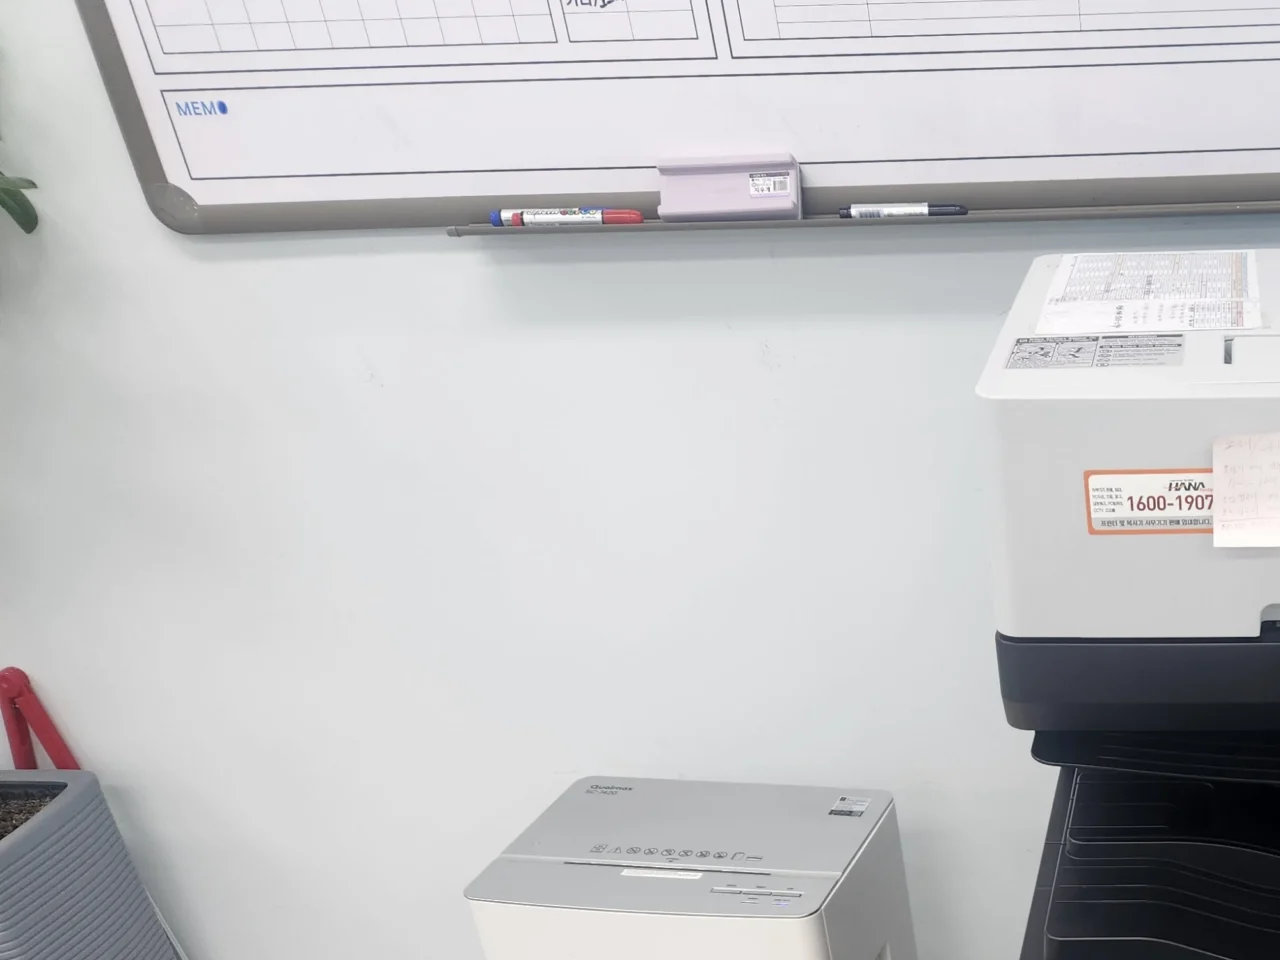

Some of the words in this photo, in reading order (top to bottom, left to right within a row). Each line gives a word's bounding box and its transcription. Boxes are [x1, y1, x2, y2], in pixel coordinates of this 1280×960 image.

[175, 100, 228, 116] MEMO
[1168, 482, 1206, 491] HANA
[1127, 494, 1214, 512] 1600-1907
